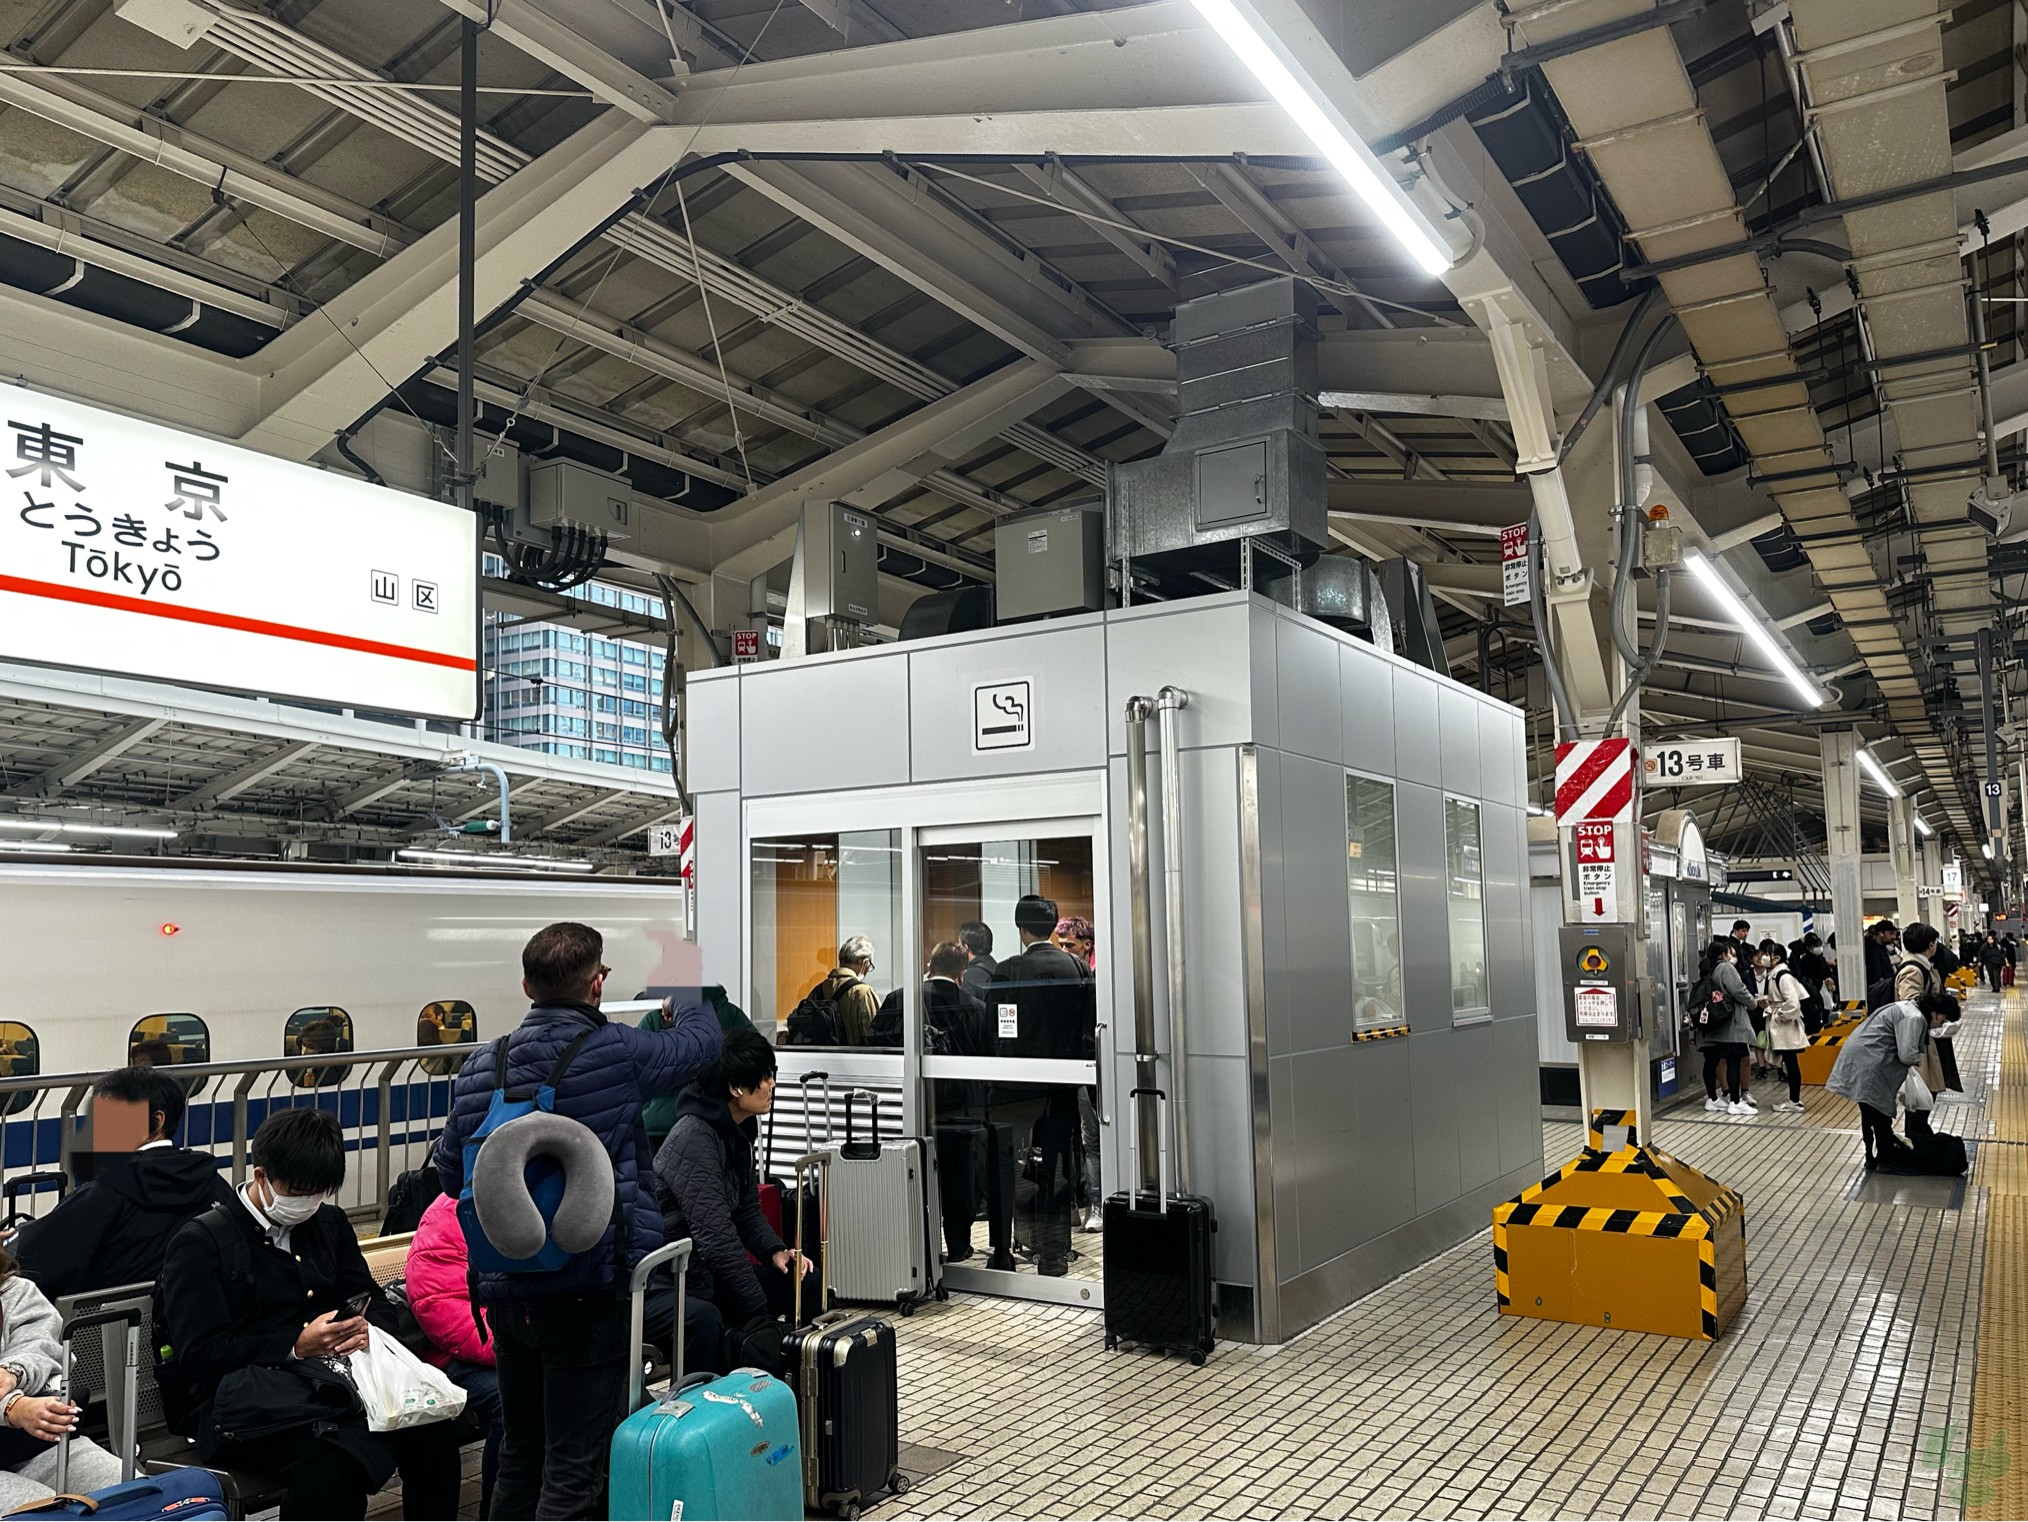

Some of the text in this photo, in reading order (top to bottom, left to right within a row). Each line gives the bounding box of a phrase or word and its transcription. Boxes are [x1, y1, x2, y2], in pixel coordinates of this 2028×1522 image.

[5, 420, 229, 522] 東京
[20, 491, 220, 561] とうきょう
[1502, 526, 1527, 540] STOP
[61, 540, 182, 595] Tōkyō
[736, 632, 757, 641] STOP
[1986, 784, 2000, 795] 13
[1578, 825, 1612, 835] STOP
[1946, 871, 1958, 882] 17
